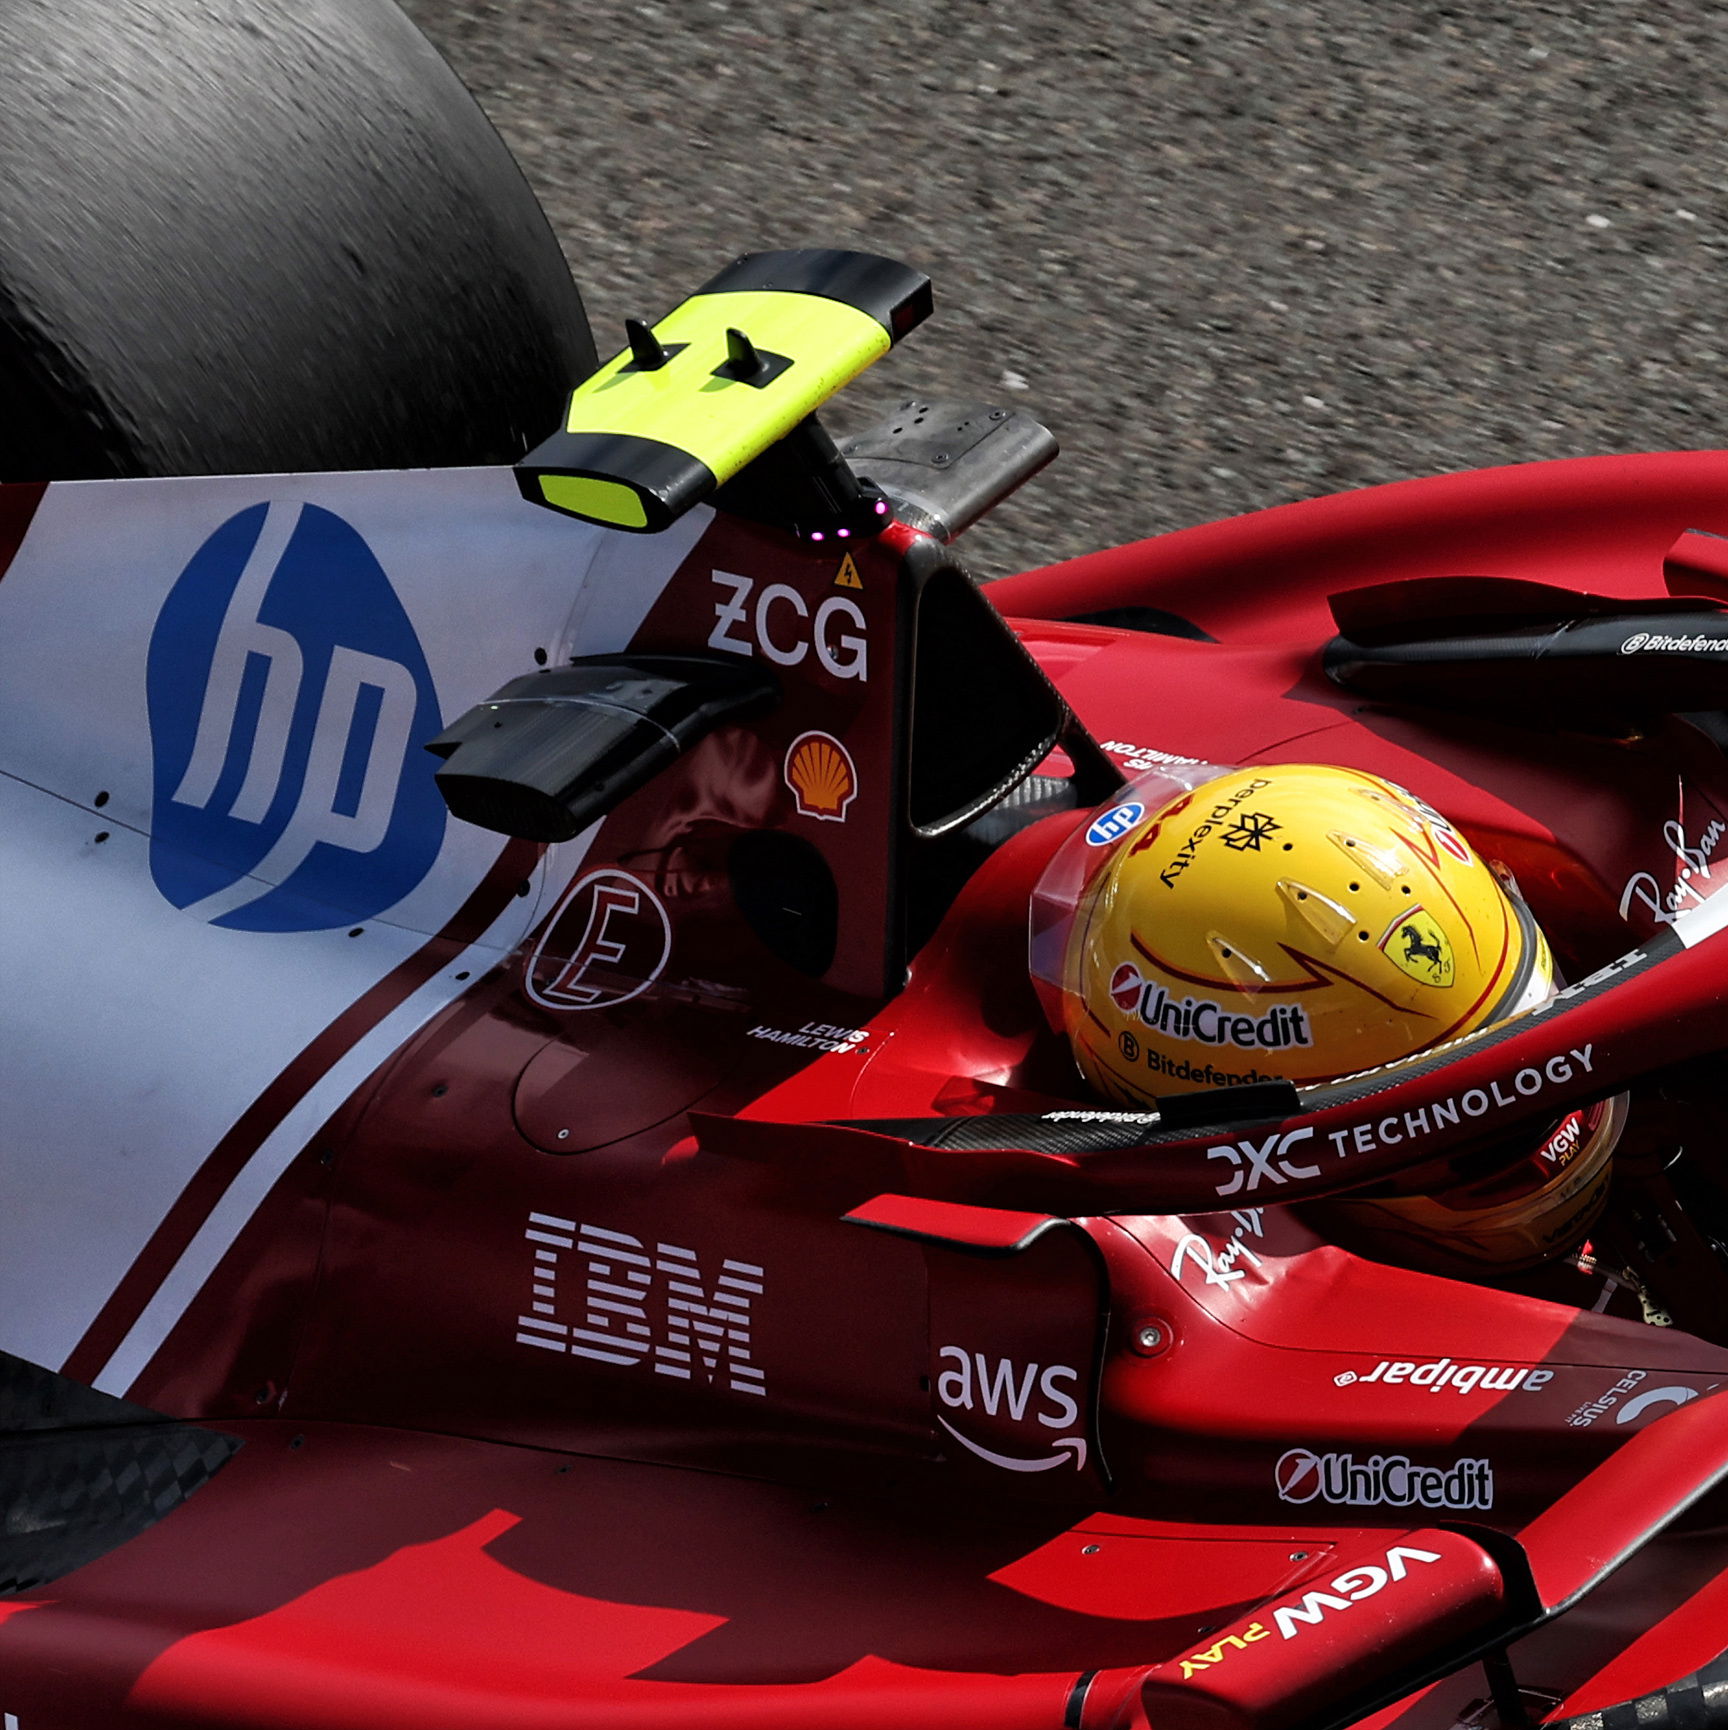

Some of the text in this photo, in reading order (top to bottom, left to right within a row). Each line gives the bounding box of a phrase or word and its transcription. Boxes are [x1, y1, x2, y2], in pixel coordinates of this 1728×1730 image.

[707, 569, 868, 682] ZCG
[172, 500, 417, 924] hp
[1100, 740, 1209, 766] AMILTON
[1160, 779, 1273, 890] perplexity
[747, 1025, 856, 1054] HAMILTON
[799, 1021, 870, 1043] LEWIS
[1139, 983, 1309, 1048] UniCredit
[1206, 1042, 1596, 1197] DXC TECHNOLOGY
[1540, 1117, 1581, 1163] VGW
[1558, 1139, 1581, 1167] PLAY
[515, 1211, 767, 1397] IBM
[937, 1345, 1079, 1429] aws
[1358, 1360, 1555, 1394] ambipar
[1323, 1458, 1494, 1510] UniCredit
[1180, 1545, 1443, 1681] VGW PLAY
